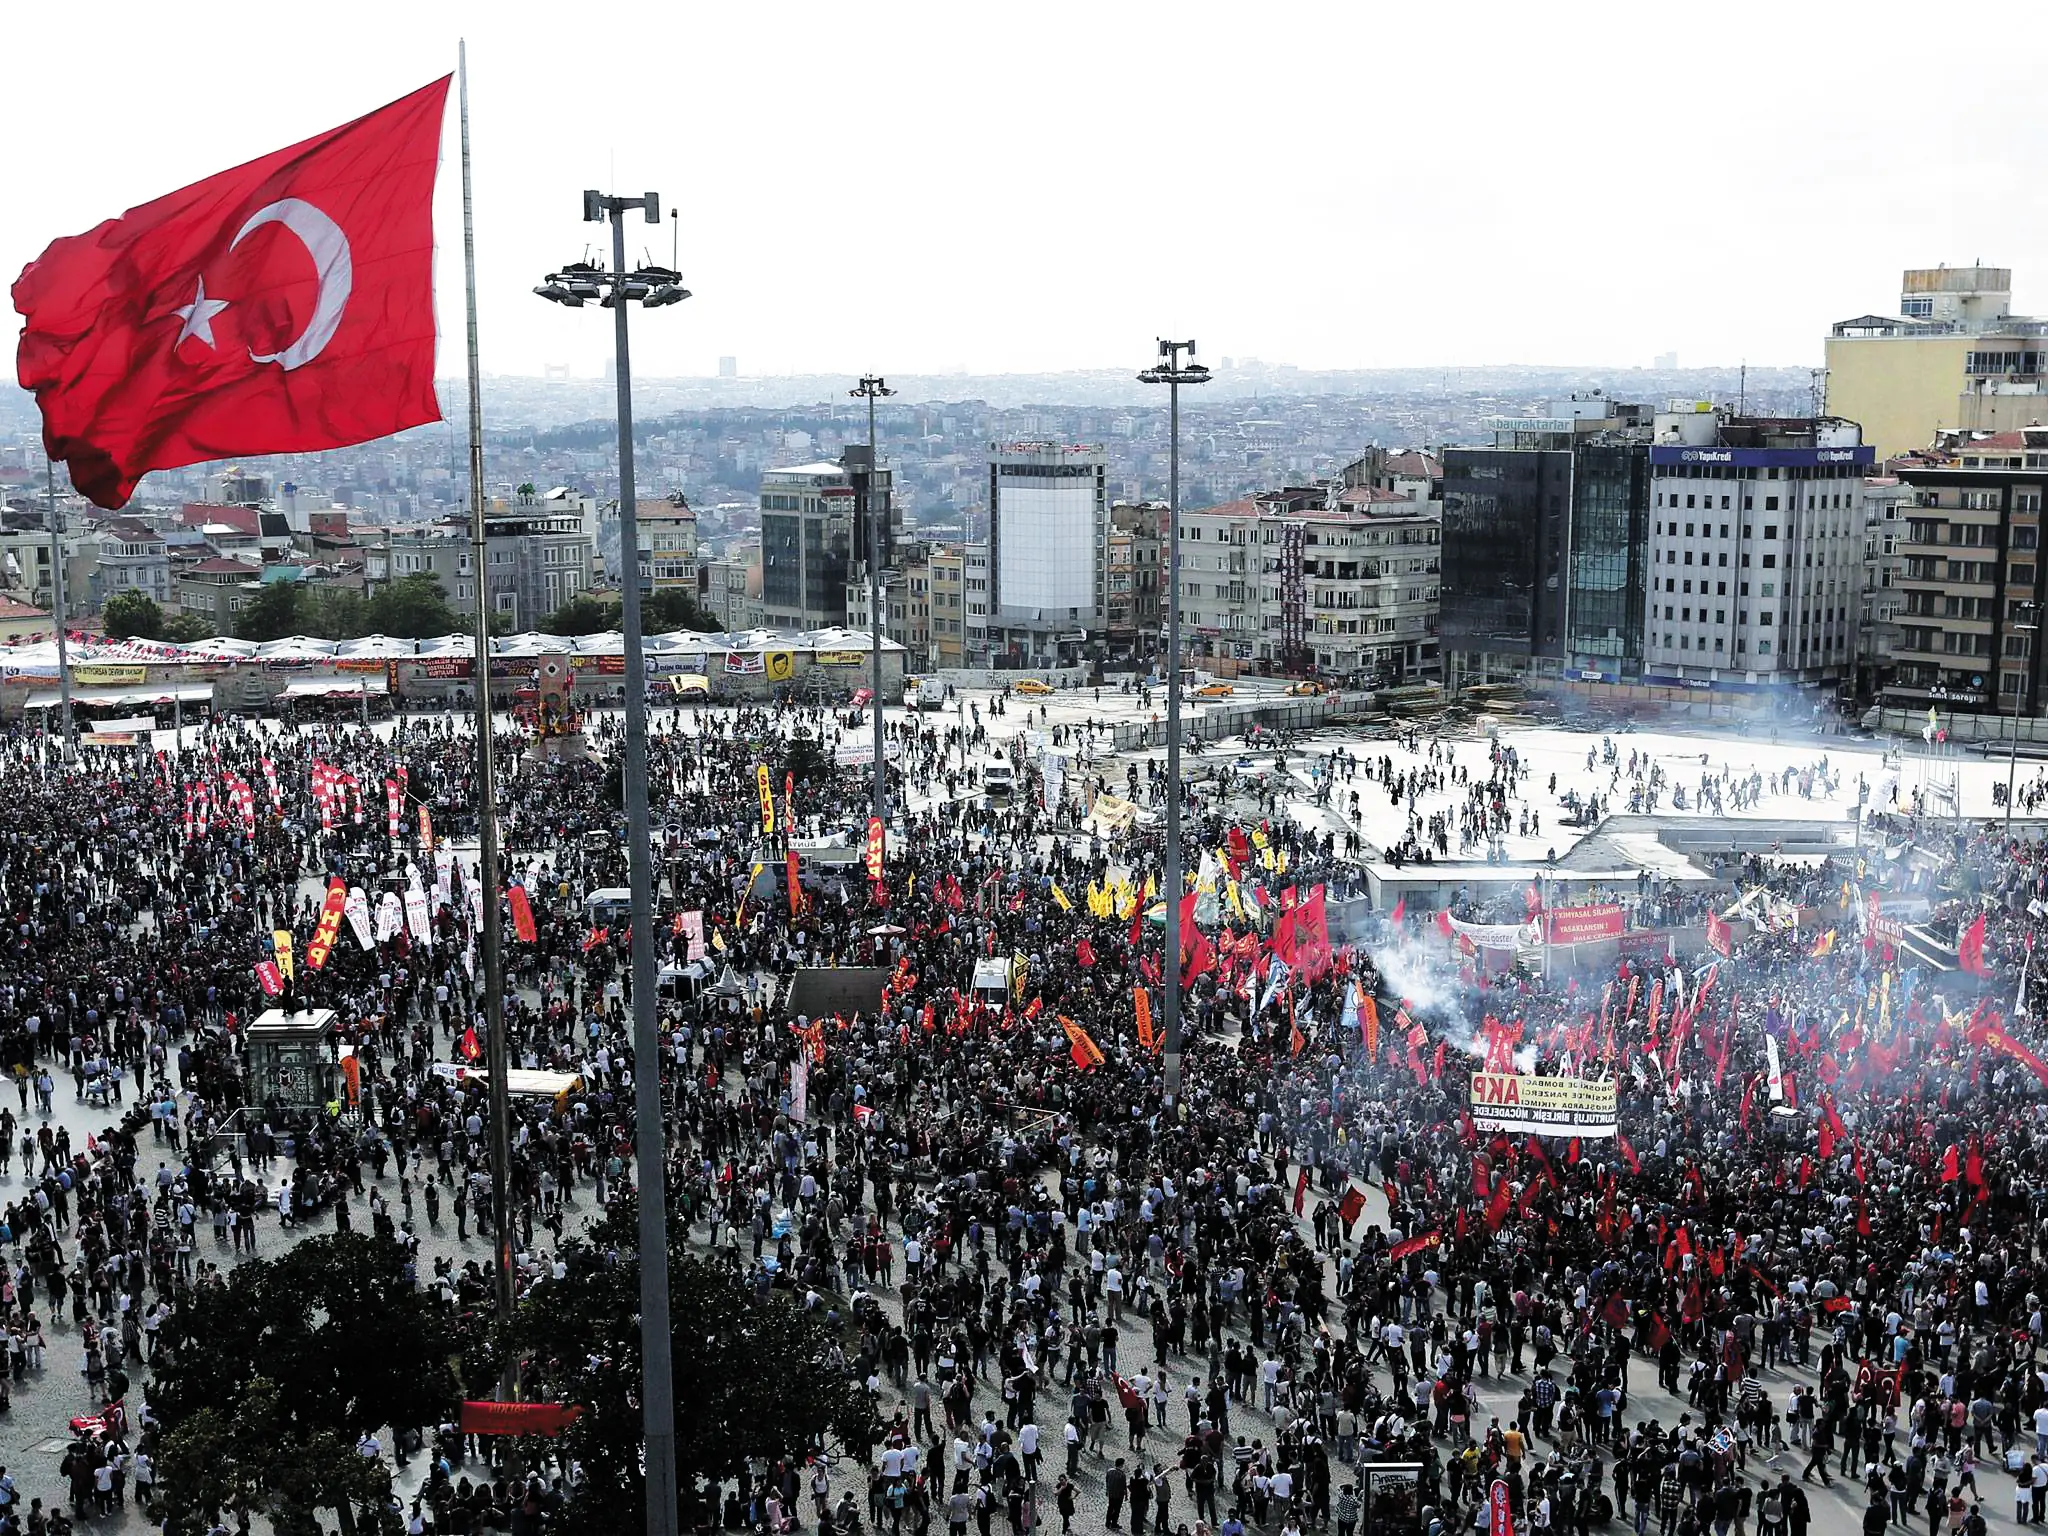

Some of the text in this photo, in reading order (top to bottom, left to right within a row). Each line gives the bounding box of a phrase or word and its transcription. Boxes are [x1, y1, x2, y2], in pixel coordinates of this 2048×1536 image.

[1497, 419, 1569, 431] bayraktarlar
[760, 774, 772, 825] SYKP
[1558, 910, 1591, 919] KİMYASAL
